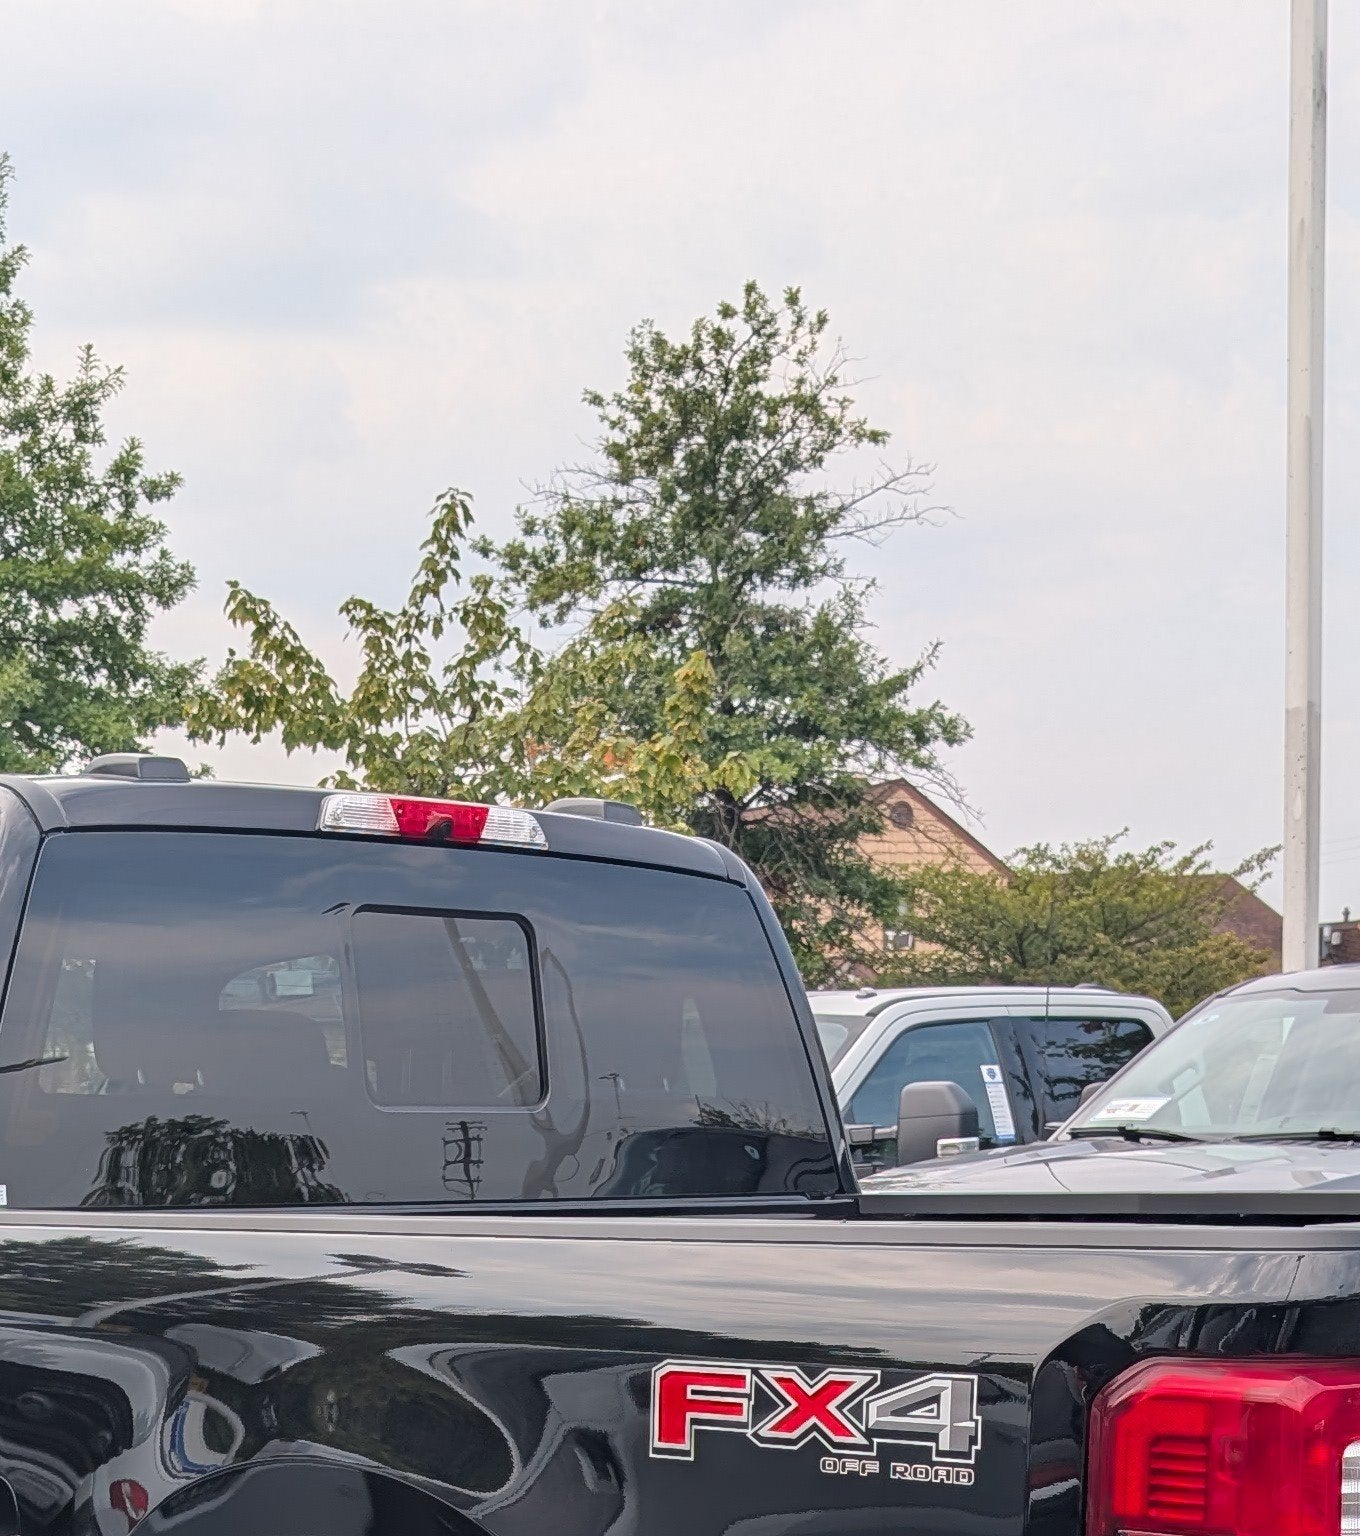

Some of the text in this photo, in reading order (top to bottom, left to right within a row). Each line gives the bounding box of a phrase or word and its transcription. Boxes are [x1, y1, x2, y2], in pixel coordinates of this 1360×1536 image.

[649, 1359, 983, 1463] FX4
[819, 1455, 976, 1486] OFF ROAD
